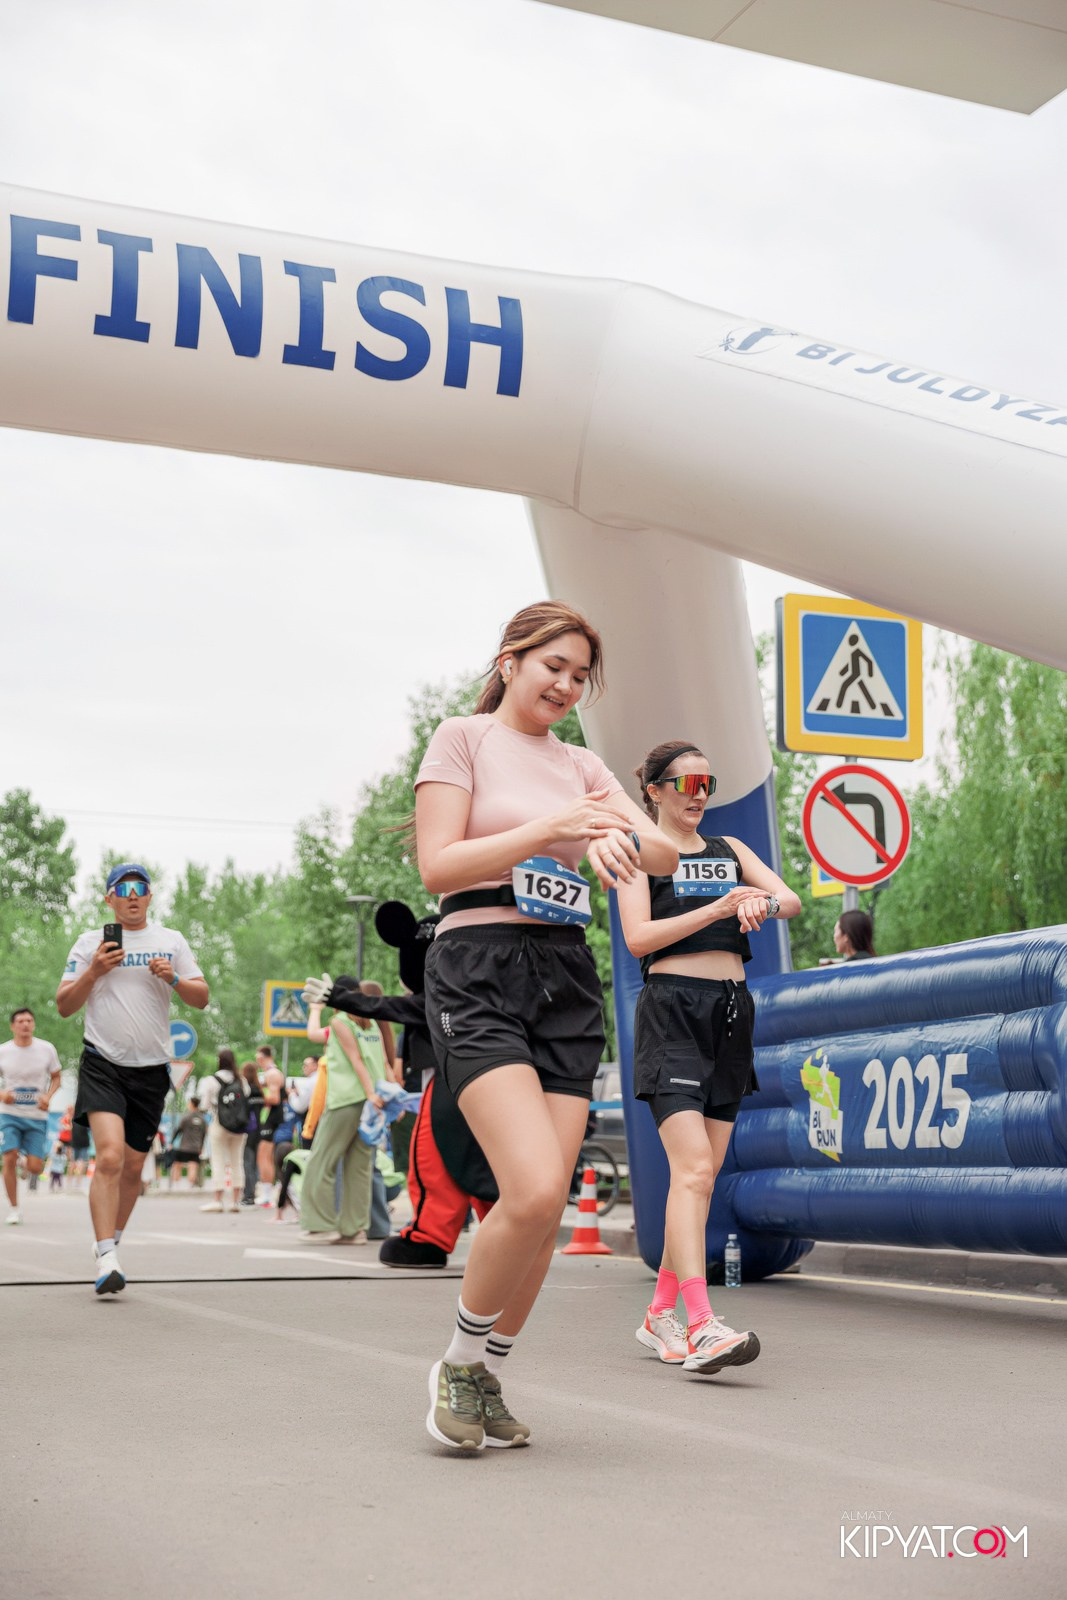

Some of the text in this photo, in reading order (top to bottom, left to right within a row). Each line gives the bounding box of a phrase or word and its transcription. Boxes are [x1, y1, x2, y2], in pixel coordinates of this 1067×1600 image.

[8, 214, 523, 397] FINISH
[796, 343, 855, 366] BI
[682, 863, 728, 880] 1156
[524, 873, 582, 907] 1627
[862, 1053, 971, 1150] 2025
[812, 1111, 821, 1129] BI
[817, 1129, 837, 1147] RUN
